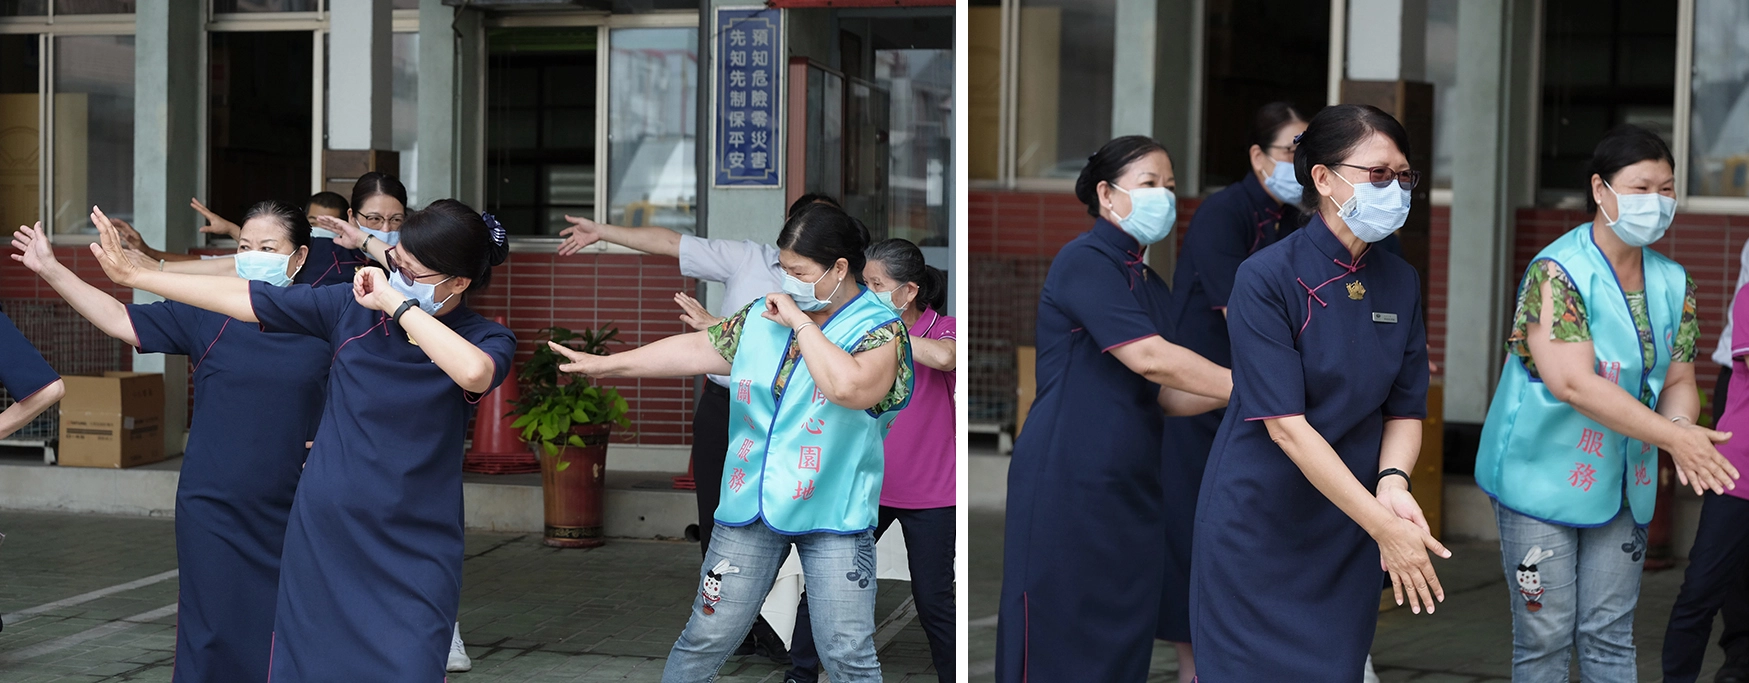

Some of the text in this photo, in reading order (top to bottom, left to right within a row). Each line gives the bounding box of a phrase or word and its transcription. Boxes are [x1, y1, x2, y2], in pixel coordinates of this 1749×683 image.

[729, 29, 746, 169] 先知先制保平安
[751, 29, 769, 169] 預知危險零災害
